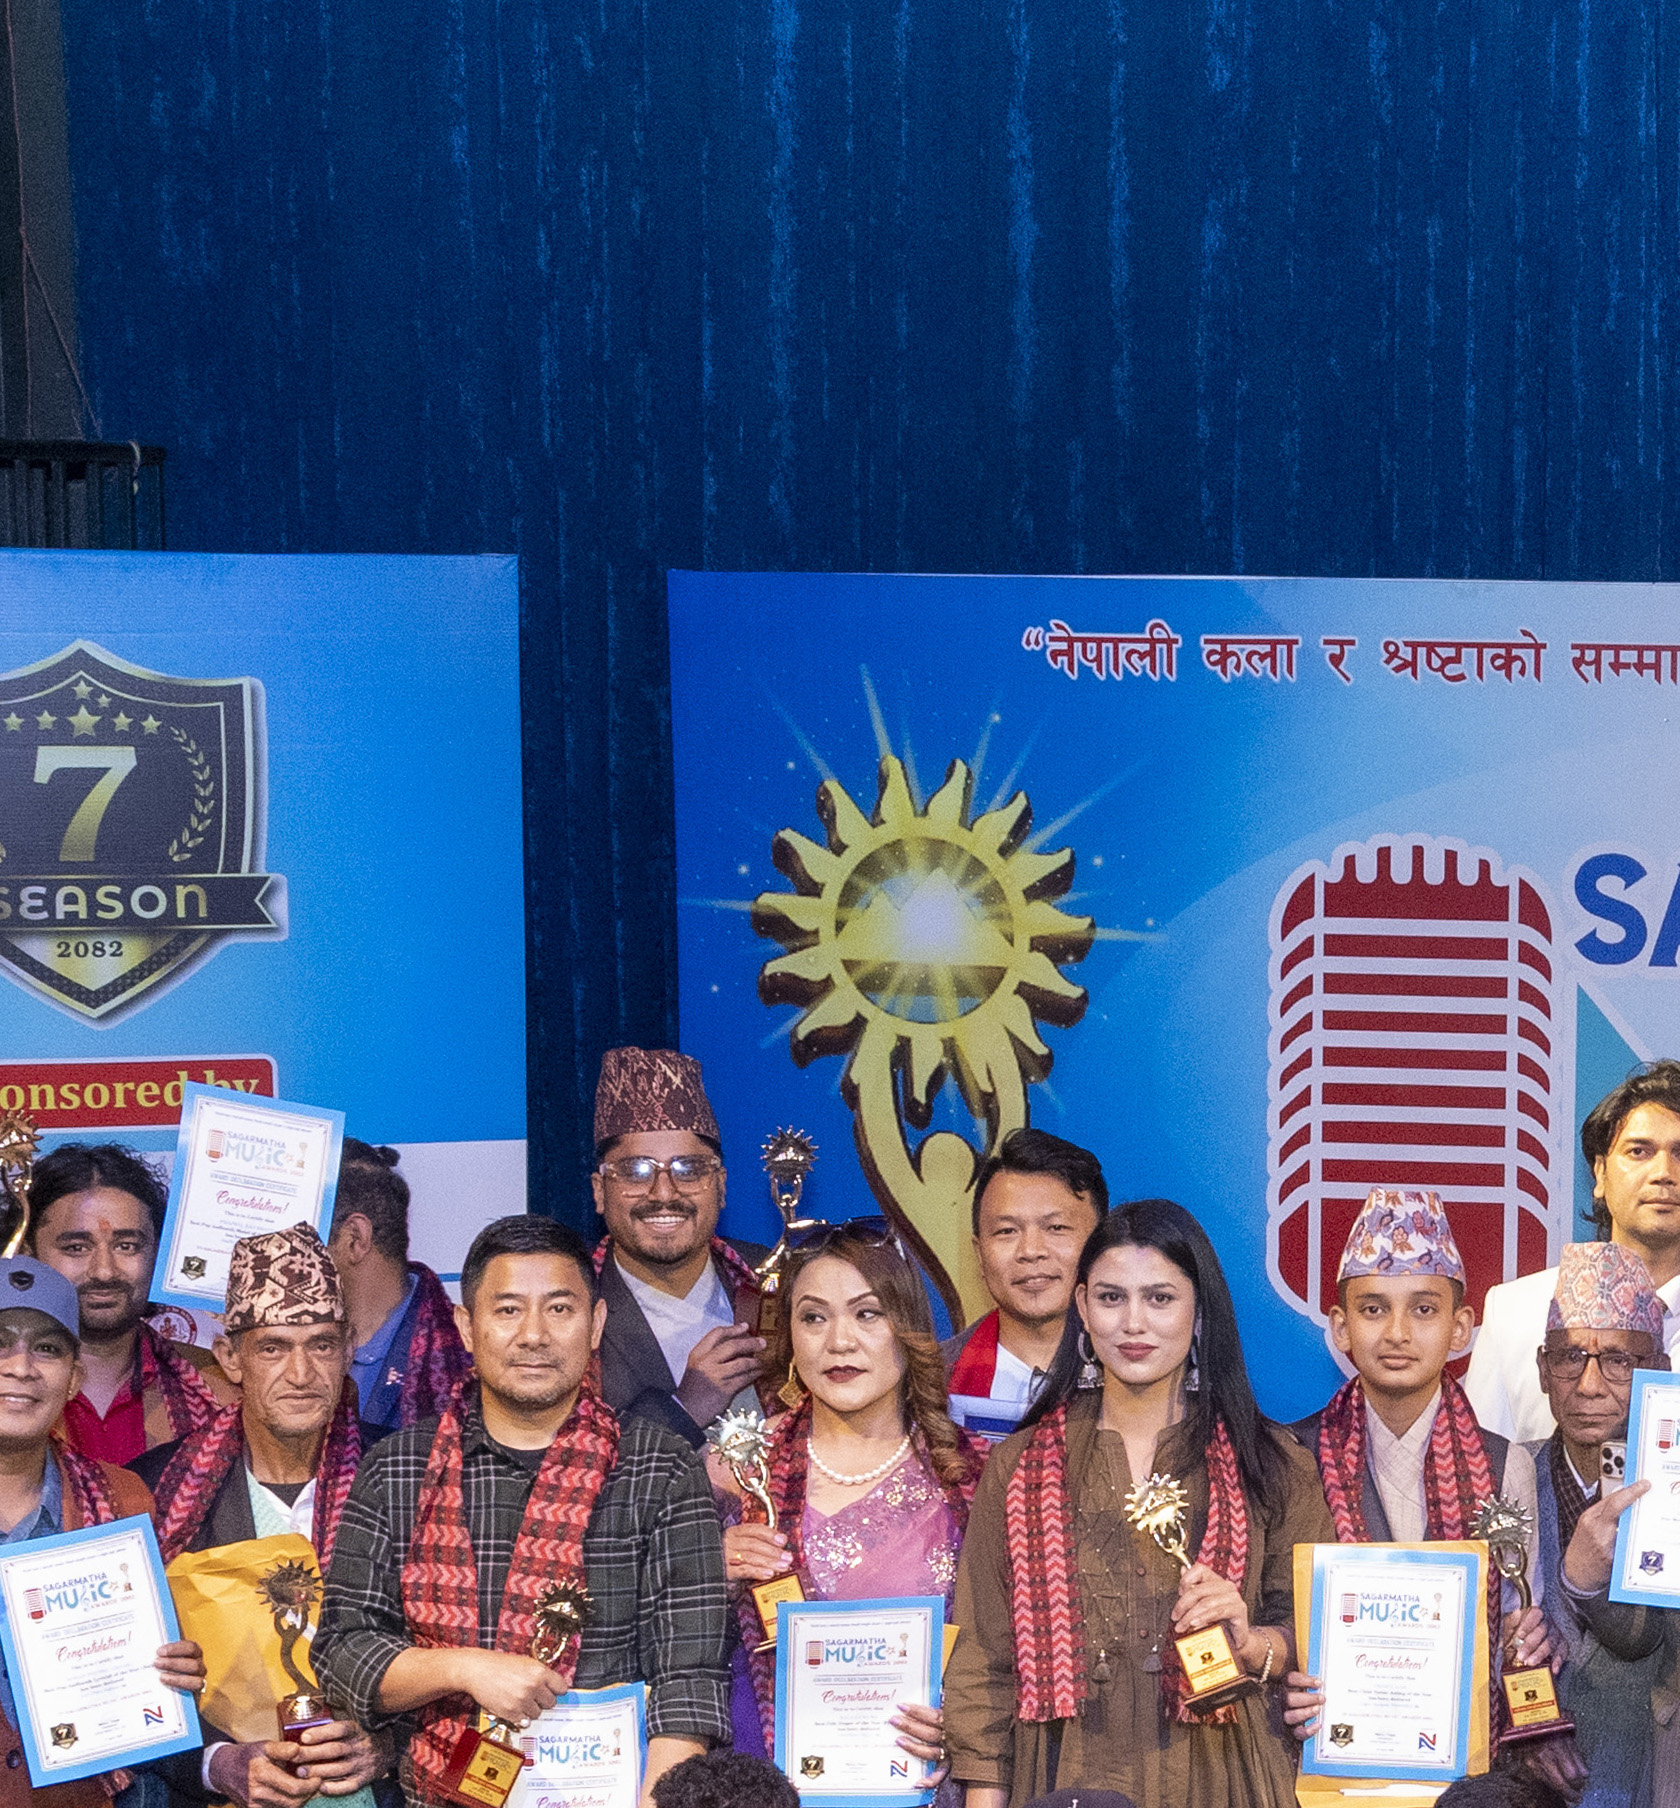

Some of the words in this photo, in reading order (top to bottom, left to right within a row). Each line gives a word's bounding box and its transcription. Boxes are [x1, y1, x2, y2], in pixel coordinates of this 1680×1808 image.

[1204, 635, 1298, 682] कला
[1322, 636, 1357, 685] र
[32, 744, 138, 864] 7
[55, 939, 125, 960] 2082
[227, 1130, 286, 1149] SAGARMATHA
[42, 1572, 108, 1593] SAGARMATHA
[1360, 1592, 1420, 1602] SAGARMATHA
[825, 1638, 886, 1646] SAGARMATHA
[539, 1735, 601, 1743] SAGARMATHA
